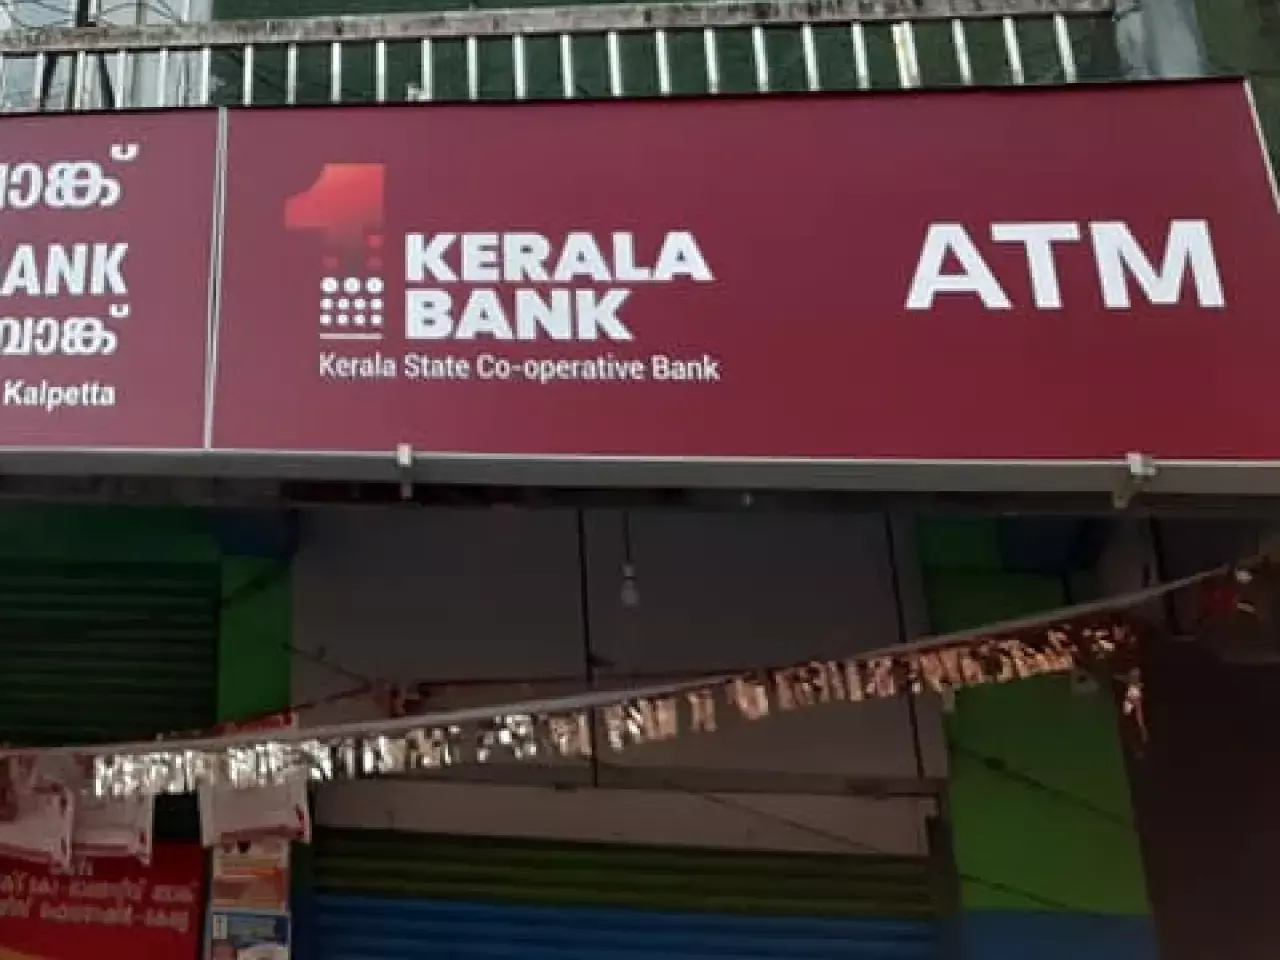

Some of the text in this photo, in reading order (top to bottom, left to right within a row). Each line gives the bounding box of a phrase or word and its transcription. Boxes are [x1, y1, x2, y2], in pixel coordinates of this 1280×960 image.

[404, 231, 716, 282] KERALA
[903, 218, 1227, 310] ATM
[404, 288, 634, 342] BANK
[319, 352, 721, 384] Kerala State Co-operative Bank
[3, 381, 116, 412] Kalpetta
